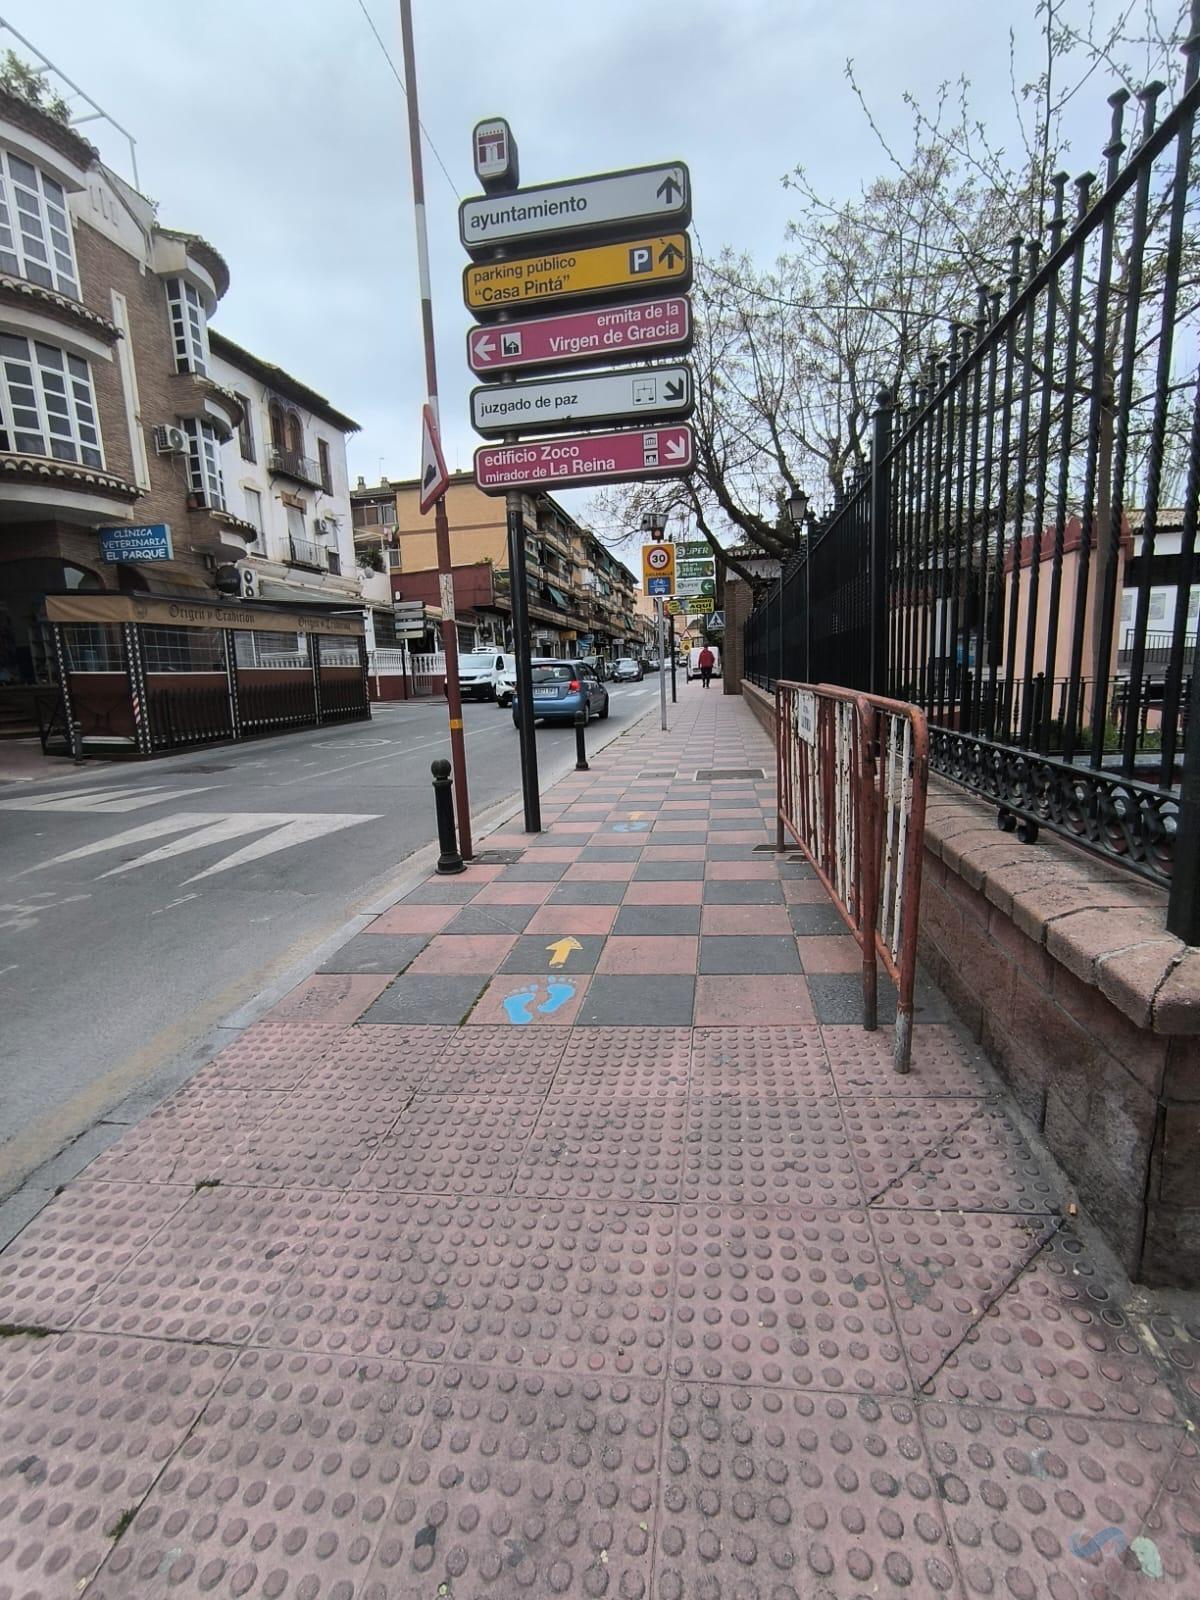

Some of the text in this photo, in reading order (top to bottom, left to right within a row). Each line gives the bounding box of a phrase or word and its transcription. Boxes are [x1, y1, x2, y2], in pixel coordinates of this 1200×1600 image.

[471, 196, 587, 230] ayuntamiento
[474, 257, 576, 285] parking público
[634, 249, 649, 272] P
[597, 302, 680, 327] ermita de la
[549, 320, 680, 353] Virgen de Gracia
[480, 394, 579, 417] juzgado de paz
[484, 446, 580, 467] edificio Zoco
[485, 457, 616, 483] mirador de La Reina
[103, 537, 168, 549] VETERINARIA
[106, 548, 166, 560] EL PARQUE
[652, 554, 666, 563] 30
